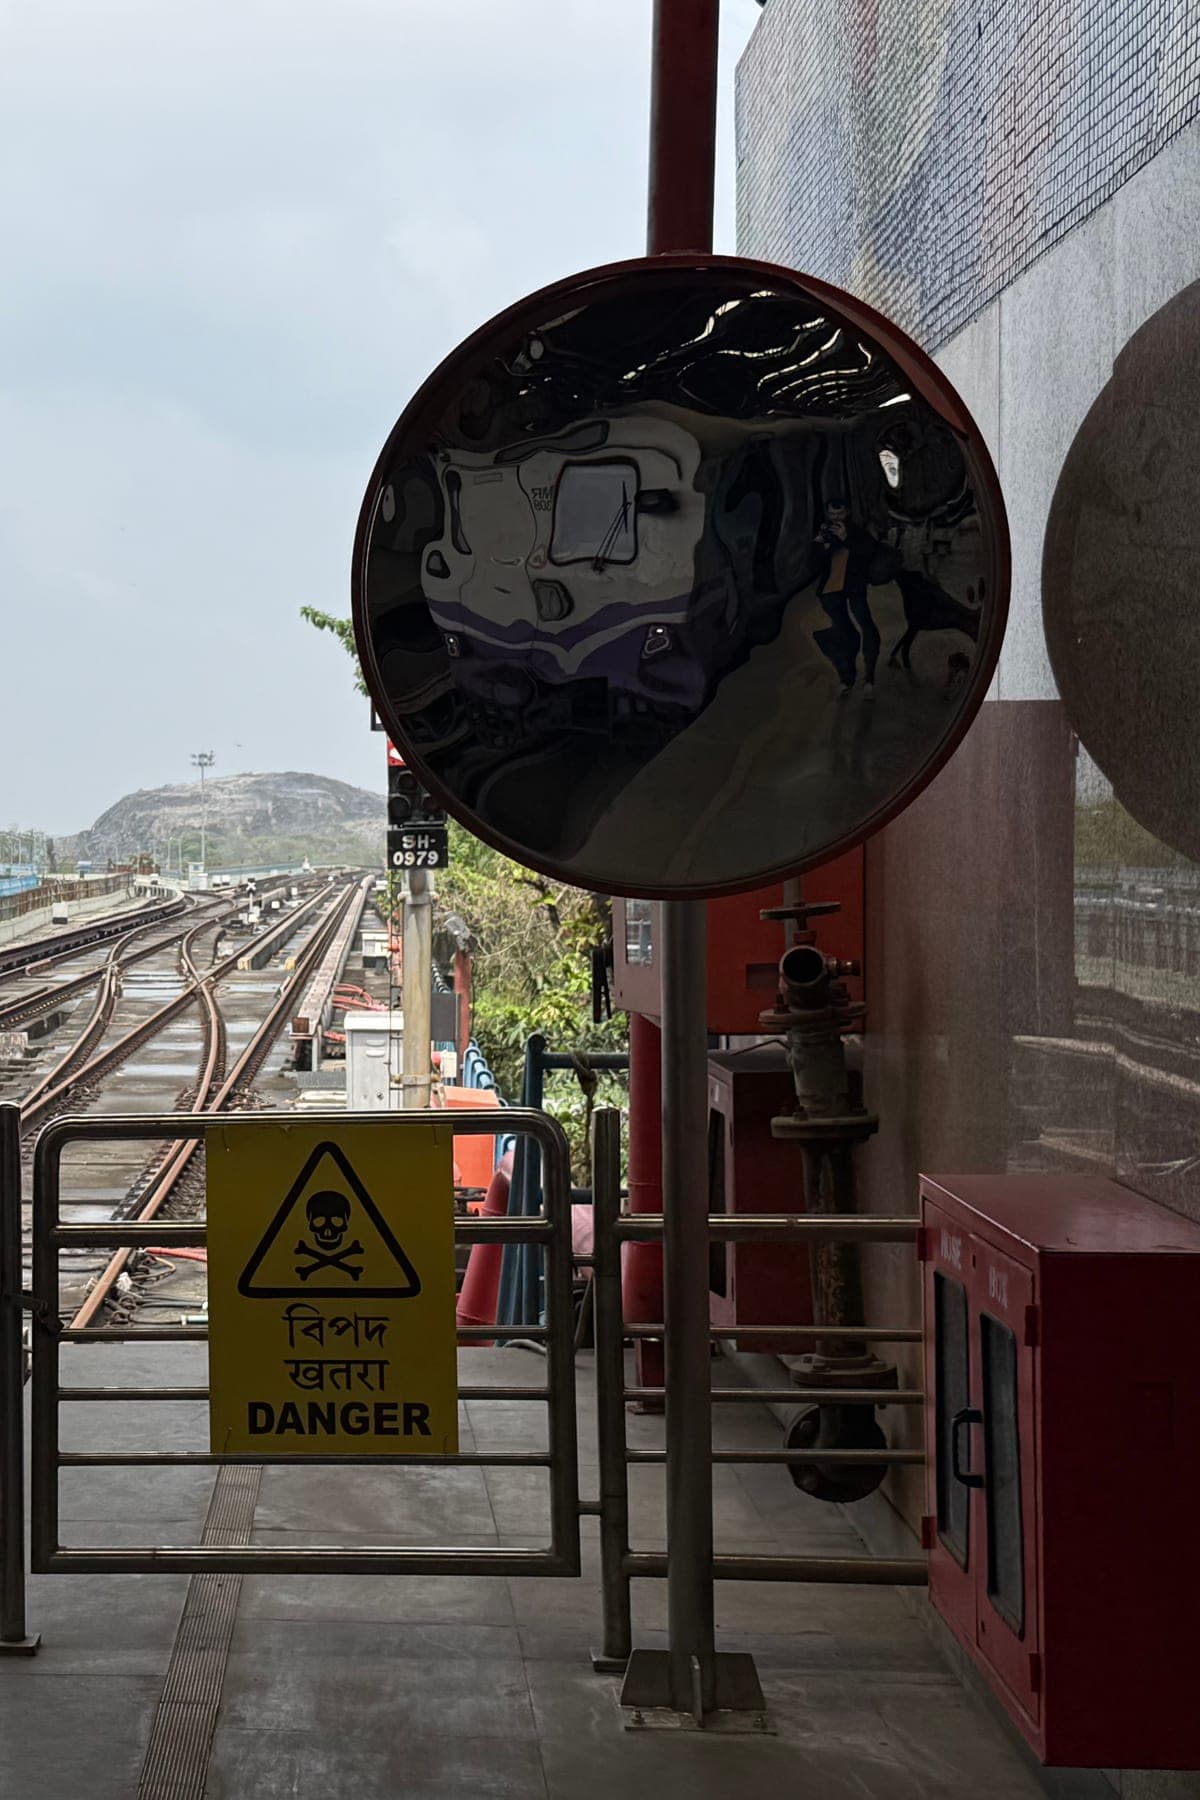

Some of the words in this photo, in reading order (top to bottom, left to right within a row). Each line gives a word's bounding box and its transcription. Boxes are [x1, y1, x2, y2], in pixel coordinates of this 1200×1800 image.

[392, 851, 439, 866] 0979
[282, 1303, 391, 1349] বিপদ
[284, 1359, 390, 1392] खतरा
[247, 1401, 432, 1436] DANGER
